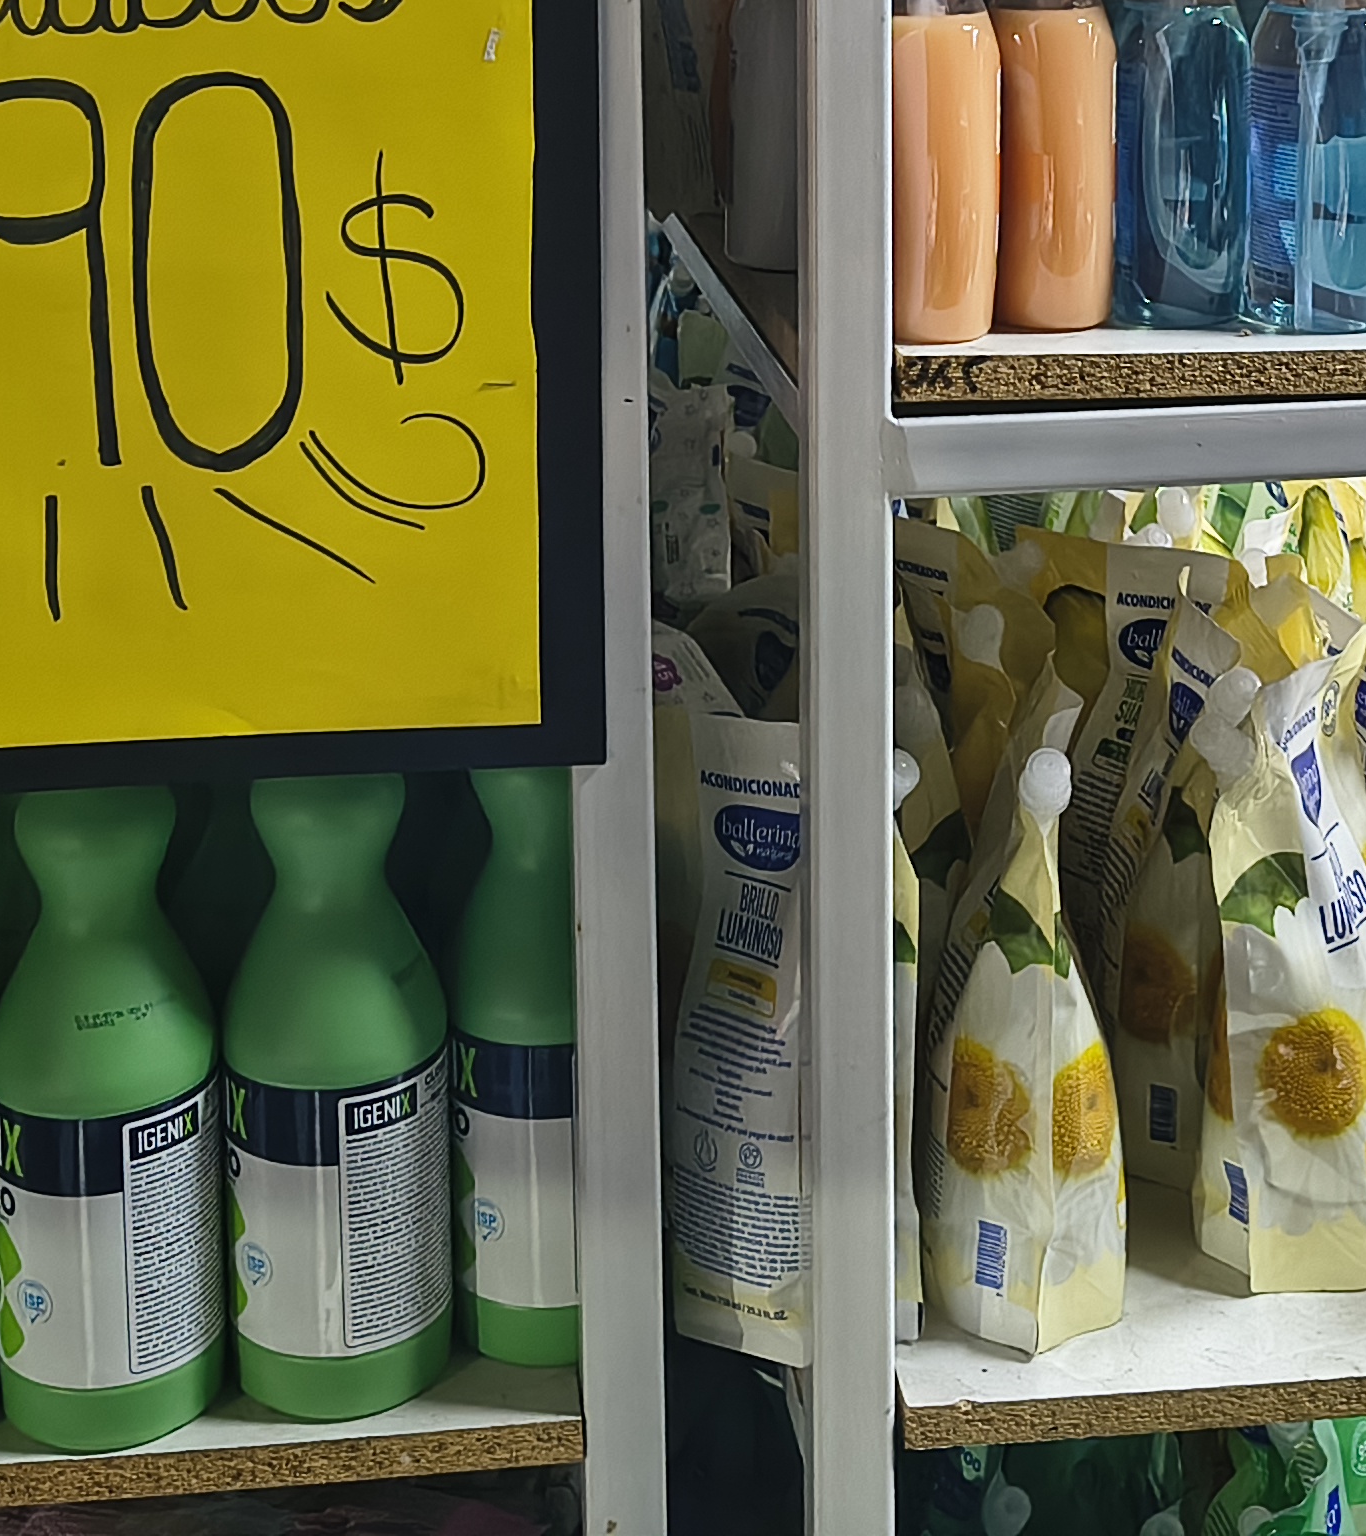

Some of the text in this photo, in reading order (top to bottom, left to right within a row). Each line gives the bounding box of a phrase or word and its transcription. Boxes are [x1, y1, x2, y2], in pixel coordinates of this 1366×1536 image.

[700, 769, 801, 799] ACONDICIONAD
[739, 882, 780, 923] BRILLO
[716, 907, 784, 962] LUMINOSO
[354, 1093, 412, 1130] IGENIX
[137, 1110, 193, 1154] IGENIX
[24, 1290, 44, 1309] ISP
